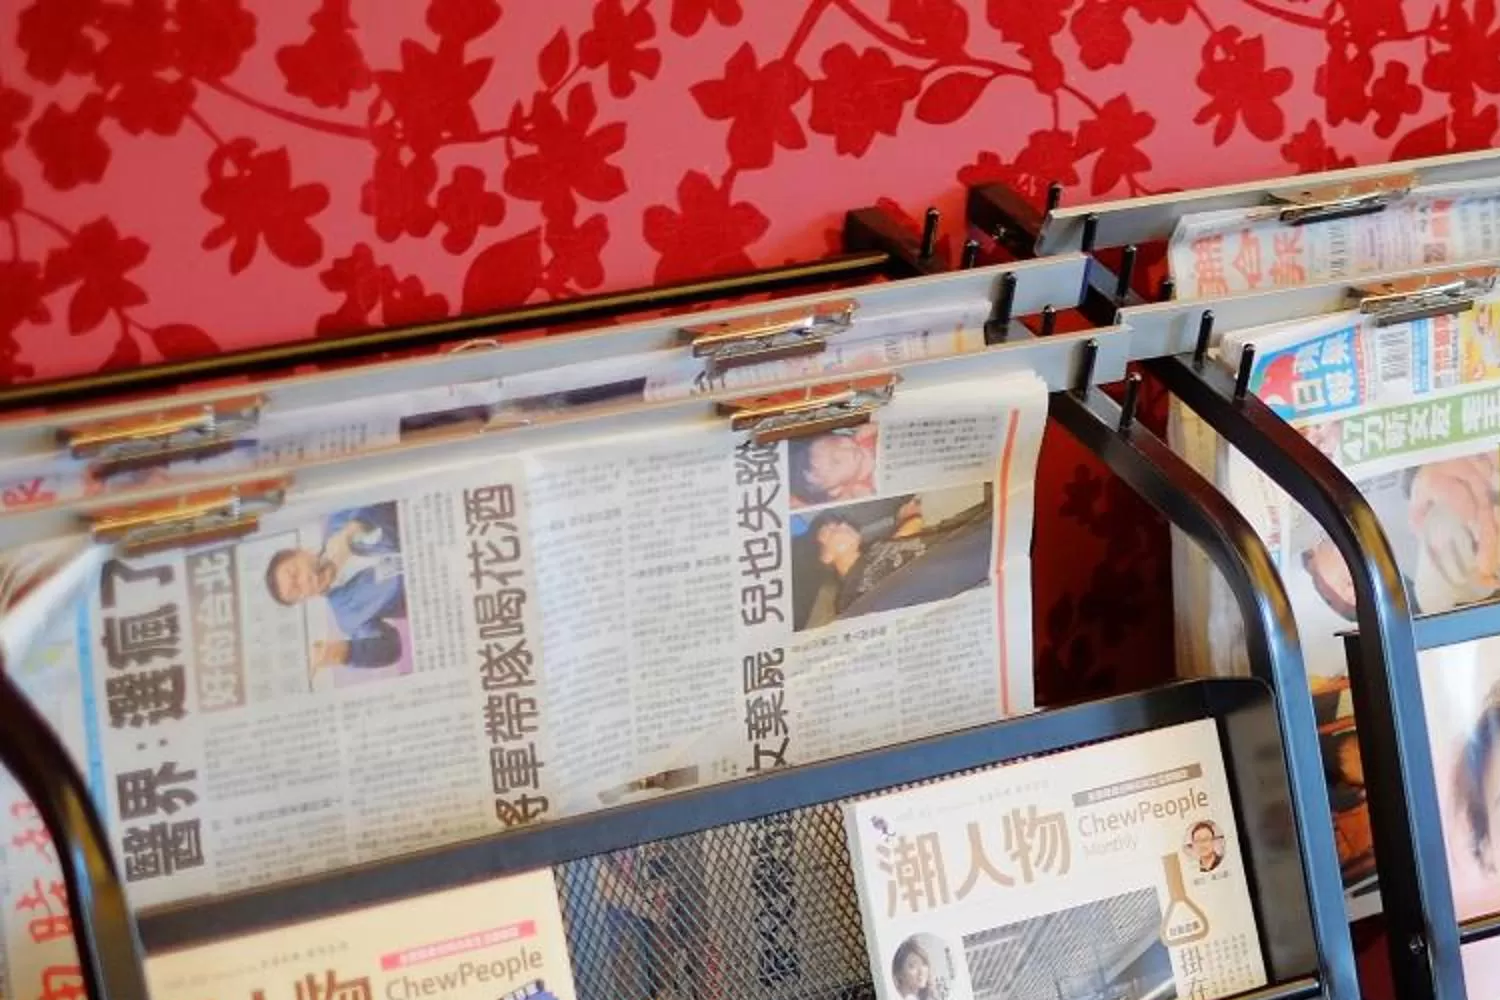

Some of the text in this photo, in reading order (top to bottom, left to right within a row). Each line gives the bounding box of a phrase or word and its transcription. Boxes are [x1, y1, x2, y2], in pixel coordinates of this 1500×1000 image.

[1077, 786, 1210, 839] ChewPeople
[876, 803, 1072, 920] 潮人物
